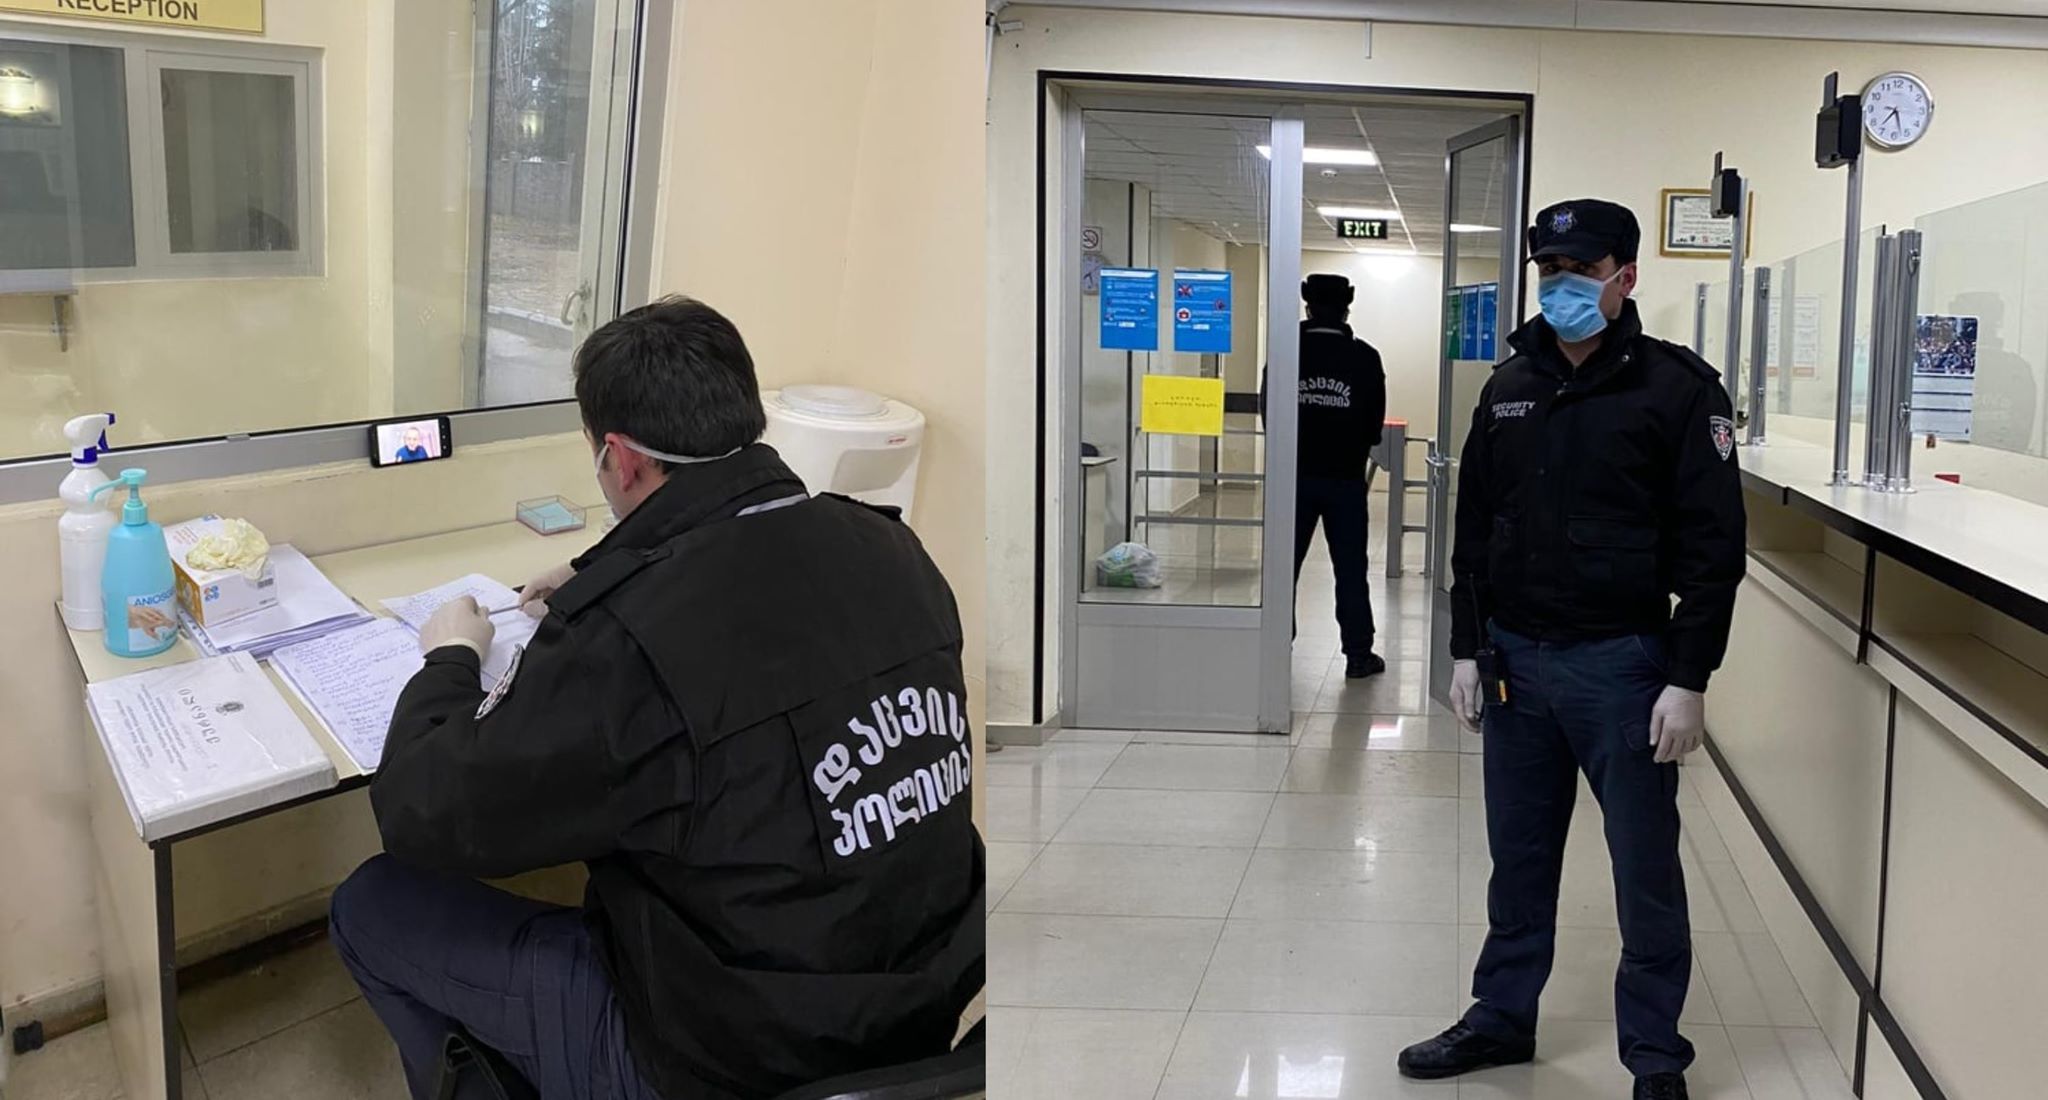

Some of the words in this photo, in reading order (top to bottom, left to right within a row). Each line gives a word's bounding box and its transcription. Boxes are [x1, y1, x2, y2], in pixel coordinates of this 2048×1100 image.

[1881, 83, 1891, 91] 11
[1893, 80, 1904, 88] 12
[1909, 84, 1913, 92] 1
[1871, 92, 1881, 101] 10
[1915, 94, 1922, 102] 2
[1867, 104, 1874, 113] 9
[1919, 107, 1926, 115] 3
[1870, 118, 1877, 126] 8
[1913, 120, 1920, 128] 4
[1879, 127, 1886, 135] 7
[1890, 131, 1898, 140] 6
[1904, 129, 1911, 138] 5
[1343, 220, 1381, 236] EXIT
[1492, 401, 1536, 412] SECURITY
[1495, 409, 1527, 419] POLICE
[813, 687, 966, 804] დაცვის
[830, 743, 971, 857] პოლიცია
